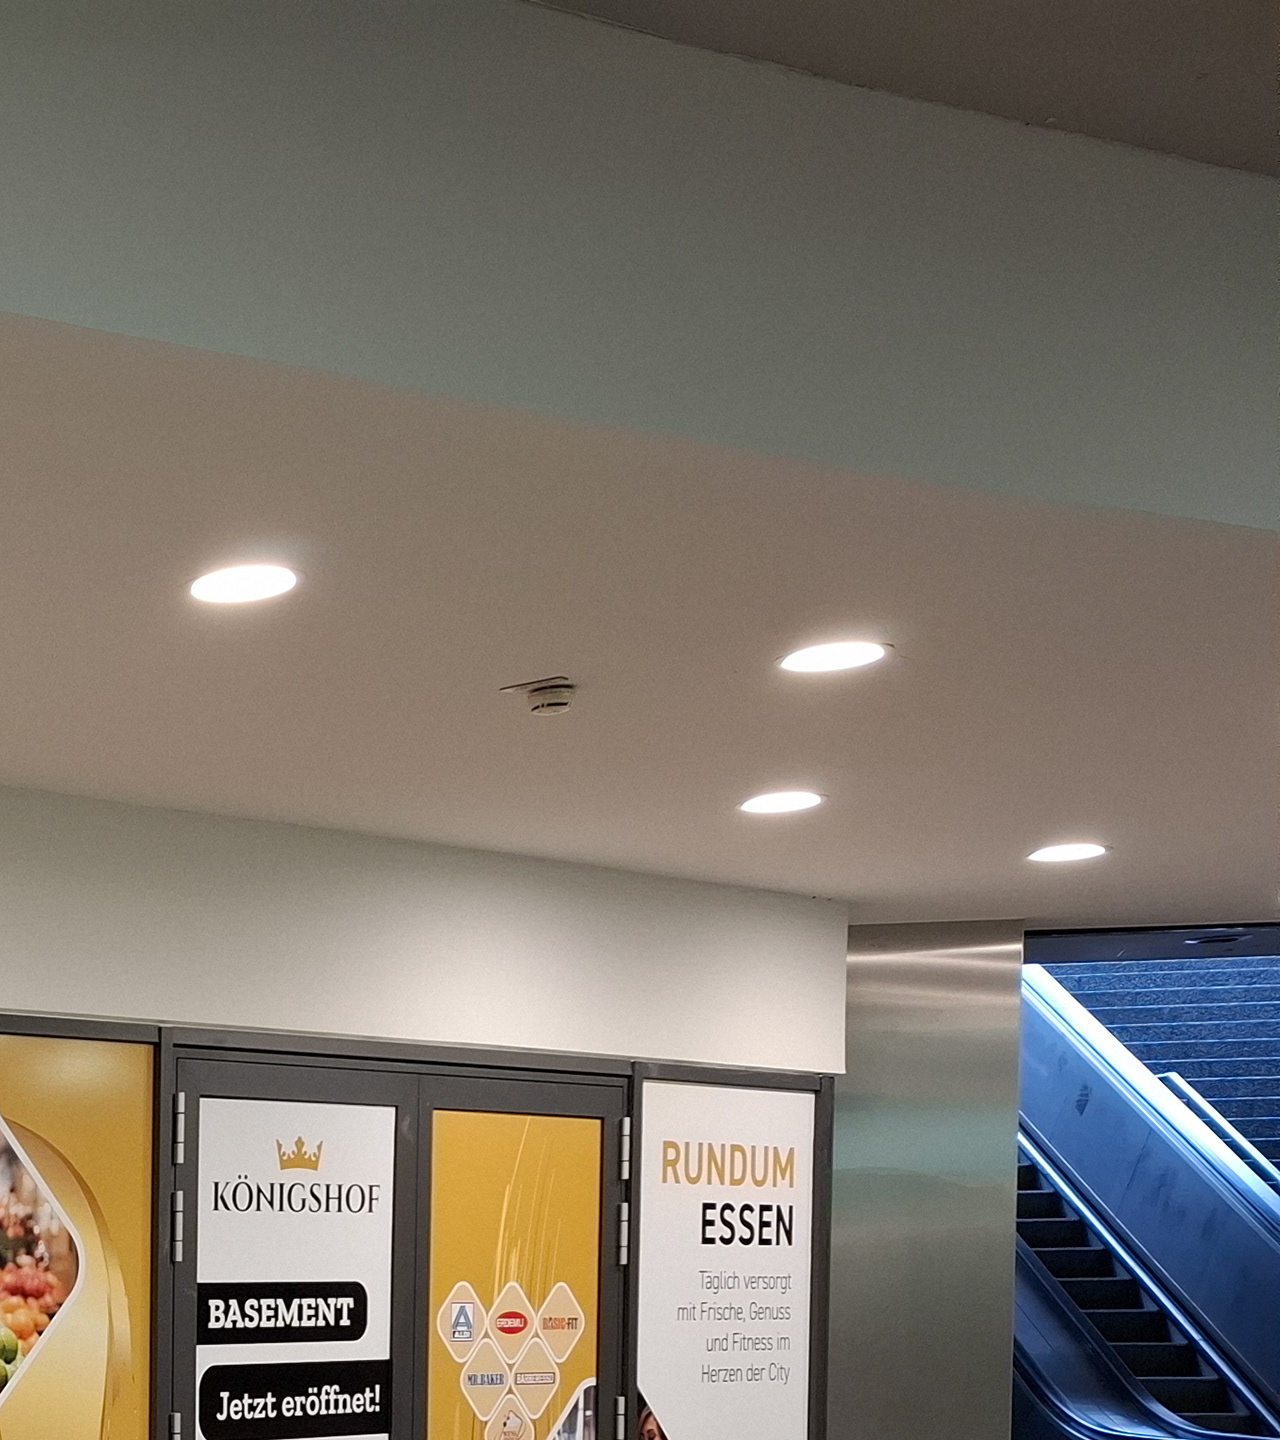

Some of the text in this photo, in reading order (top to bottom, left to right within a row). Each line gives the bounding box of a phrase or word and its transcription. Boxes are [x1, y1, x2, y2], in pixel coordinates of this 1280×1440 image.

[661, 1140, 796, 1189] RUNDUM
[212, 1174, 381, 1213] KÖNIGSHOF
[700, 1202, 794, 1247] ESSEN
[698, 1270, 792, 1295] Täglich versorgt
[208, 1297, 355, 1329] BASEMENT
[677, 1301, 791, 1323] mit Frische, Genuss
[706, 1332, 791, 1352] und Fitness im
[701, 1362, 791, 1385] Herzen der City
[216, 1384, 381, 1421] Jetzt eröffnet!
